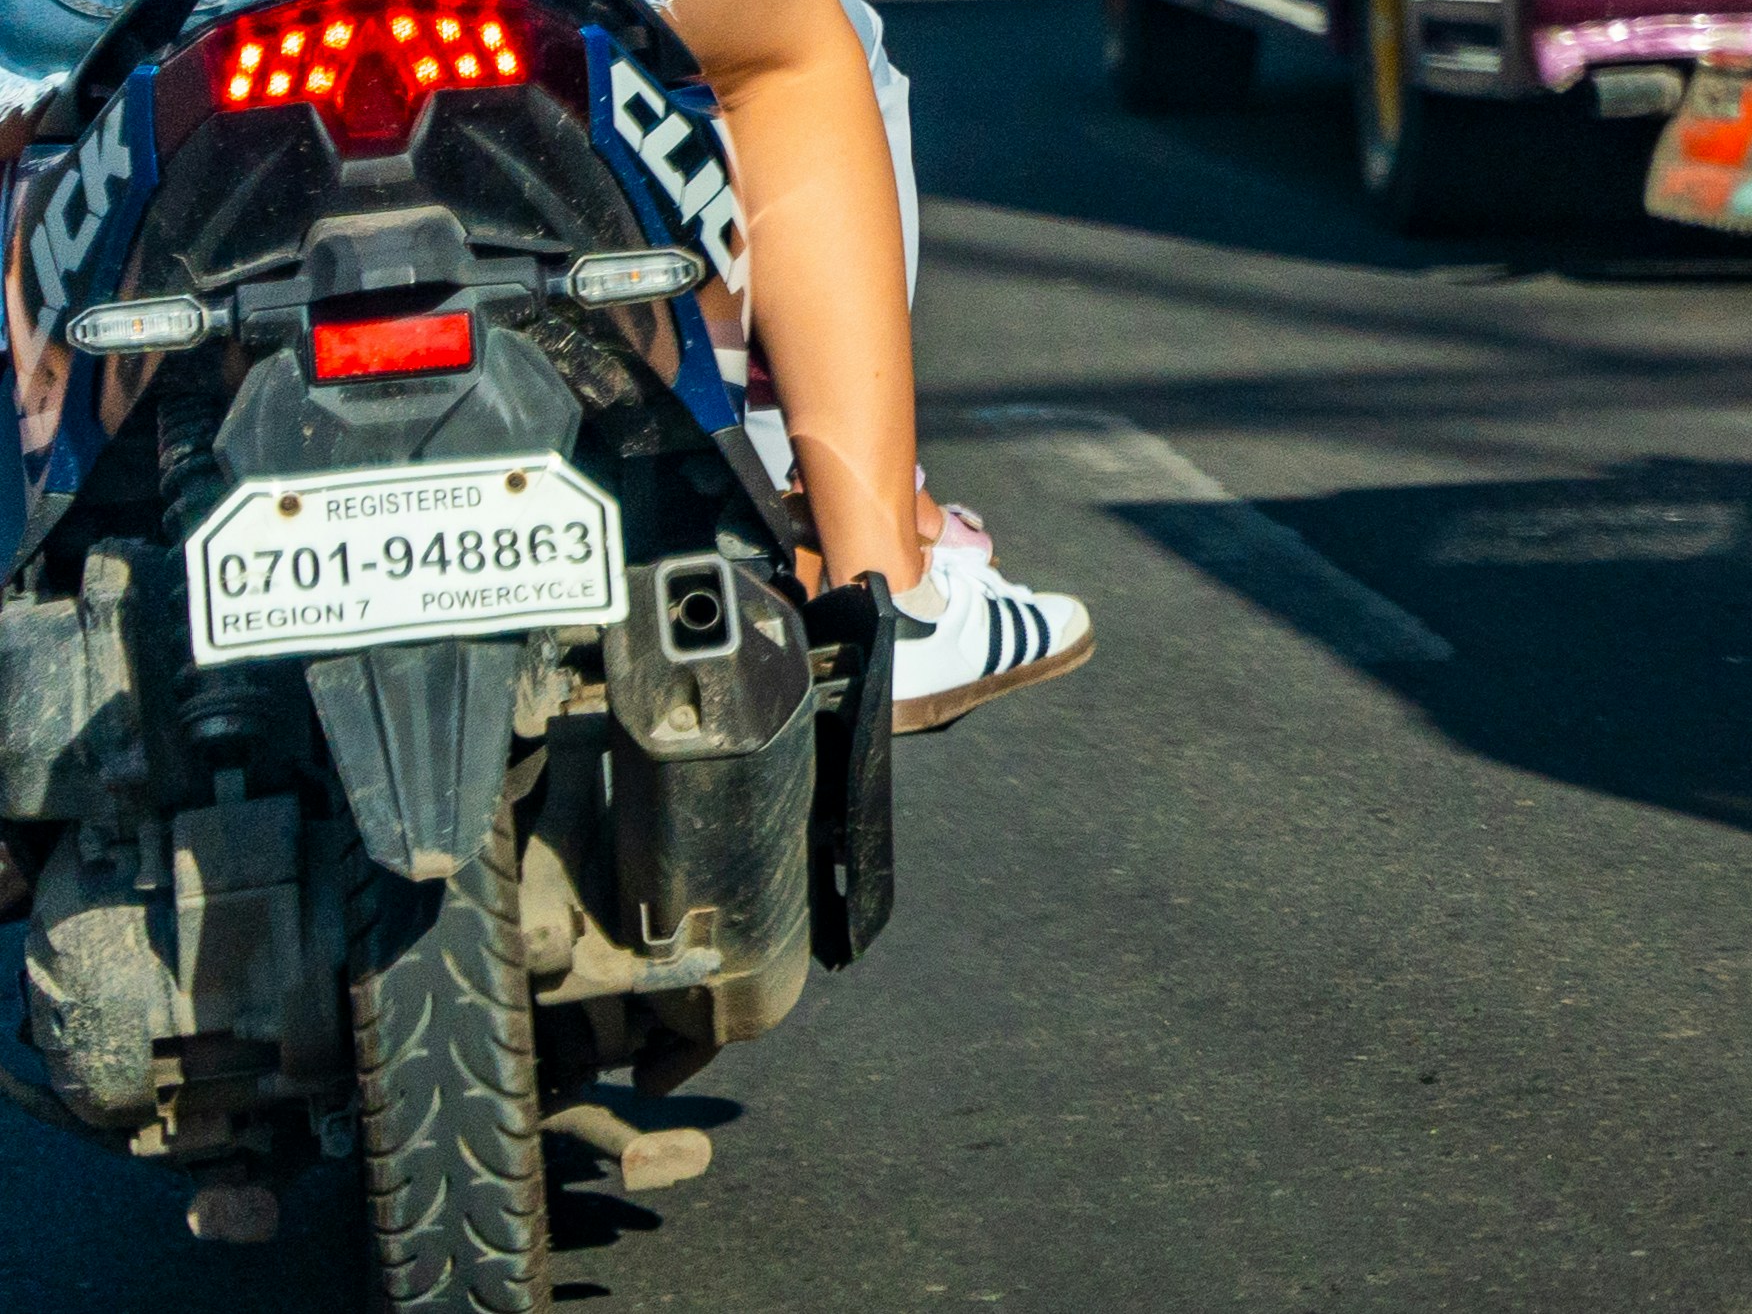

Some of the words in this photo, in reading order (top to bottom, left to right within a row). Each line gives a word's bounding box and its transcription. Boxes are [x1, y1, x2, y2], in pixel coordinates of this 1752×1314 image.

[326, 485, 483, 523] REGISTERED
[218, 519, 595, 600] 0701-948863
[222, 602, 345, 635] REGION
[355, 599, 372, 620] 7
[421, 579, 597, 614] POWERCYCLE
